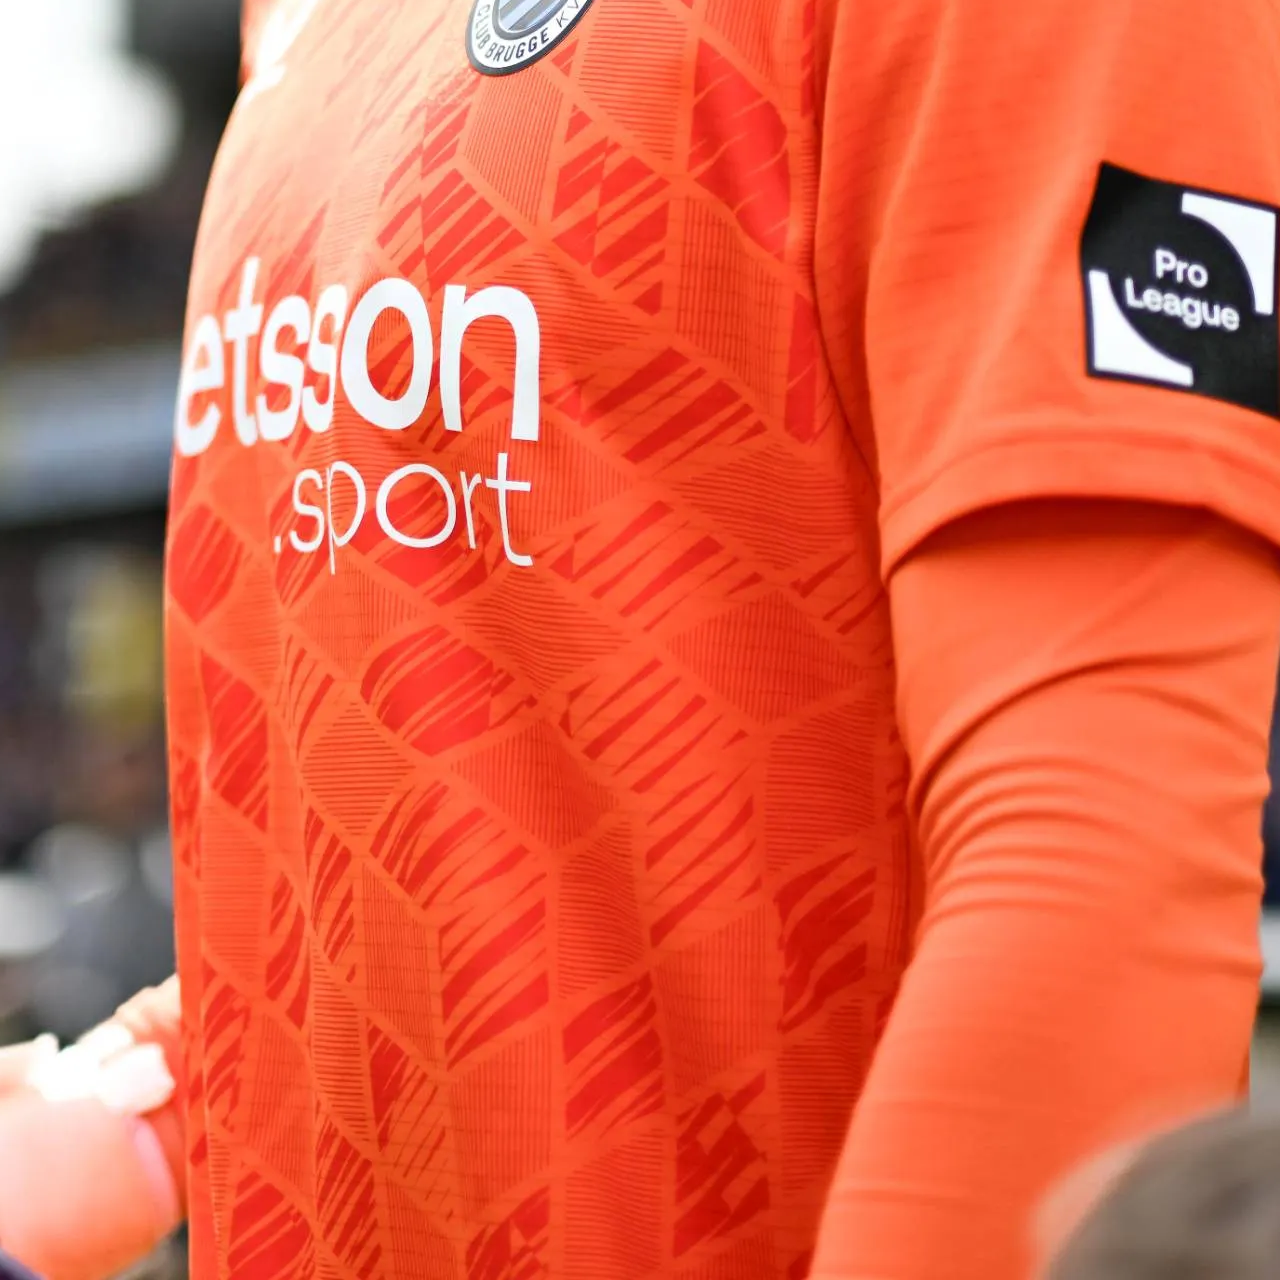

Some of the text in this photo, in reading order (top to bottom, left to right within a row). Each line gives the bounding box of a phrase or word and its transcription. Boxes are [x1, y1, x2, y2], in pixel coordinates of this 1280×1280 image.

[475, 3, 491, 50] CLUB
[484, 27, 549, 62] BRUGGE
[1154, 247, 1209, 289] Pro
[1123, 275, 1241, 332] League
[174, 256, 541, 457] etsson
[273, 451, 534, 576] .sport
